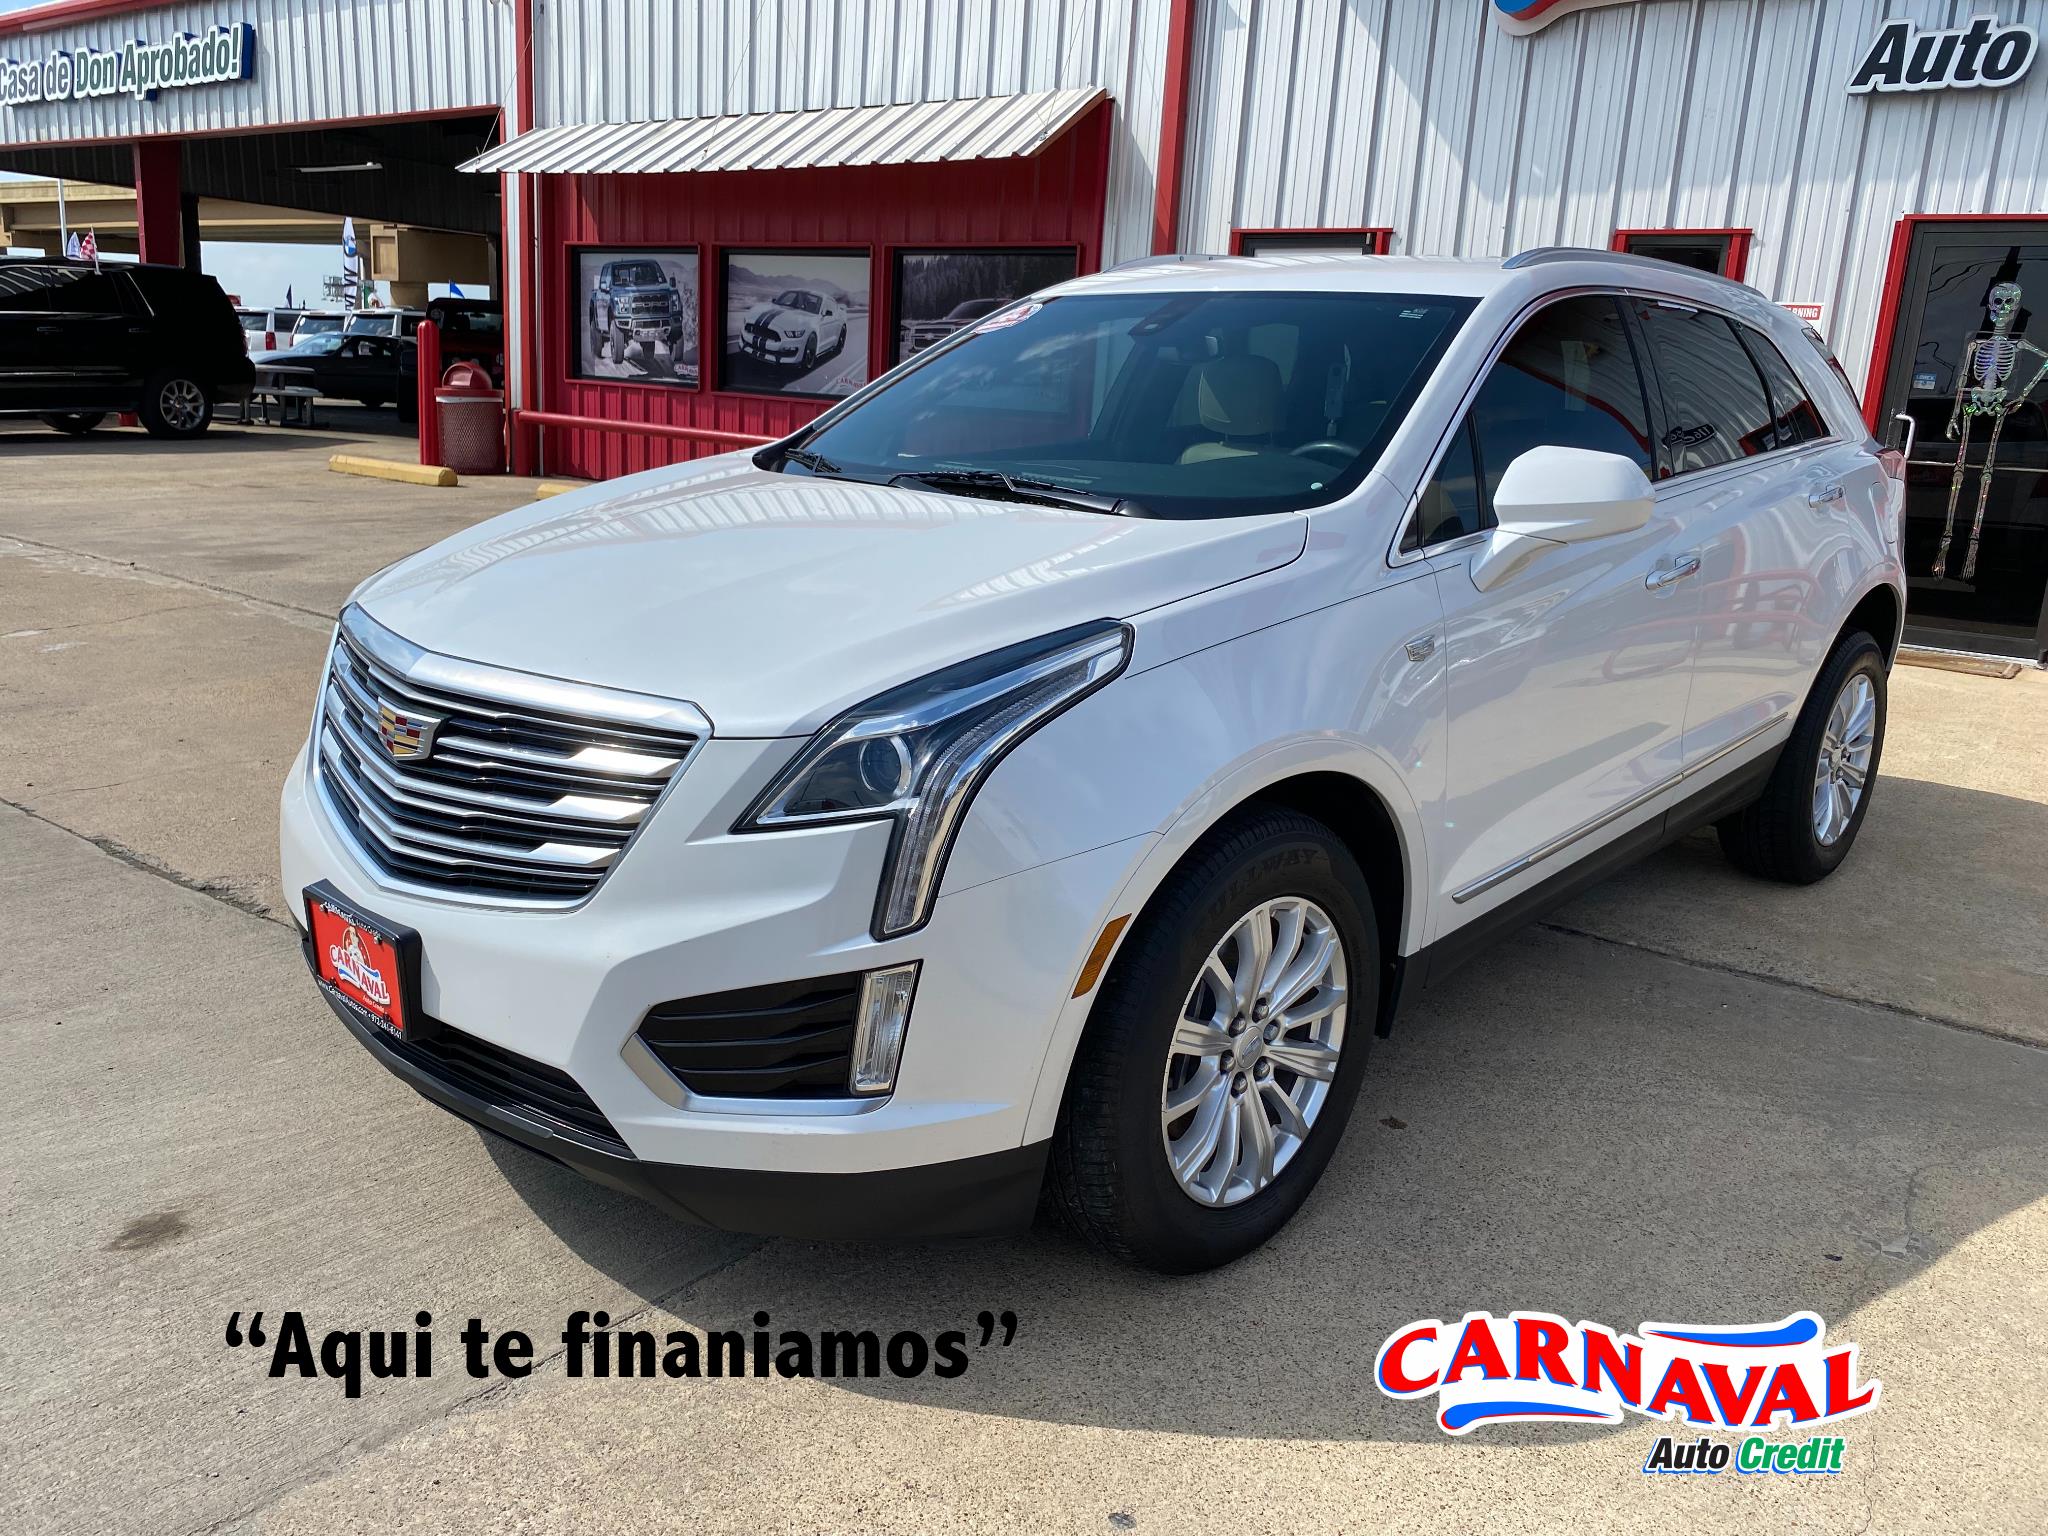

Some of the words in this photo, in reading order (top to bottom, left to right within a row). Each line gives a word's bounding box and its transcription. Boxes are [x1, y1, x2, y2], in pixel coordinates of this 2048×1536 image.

[0, 63, 39, 100] Casa
[46, 55, 70, 95] de
[76, 50, 116, 93] Don
[121, 27, 241, 95] Aprobado!
[1849, 18, 2029, 88] Auto
[1788, 307, 1818, 318] RNING
[331, 946, 390, 1001] CARNAVAL
